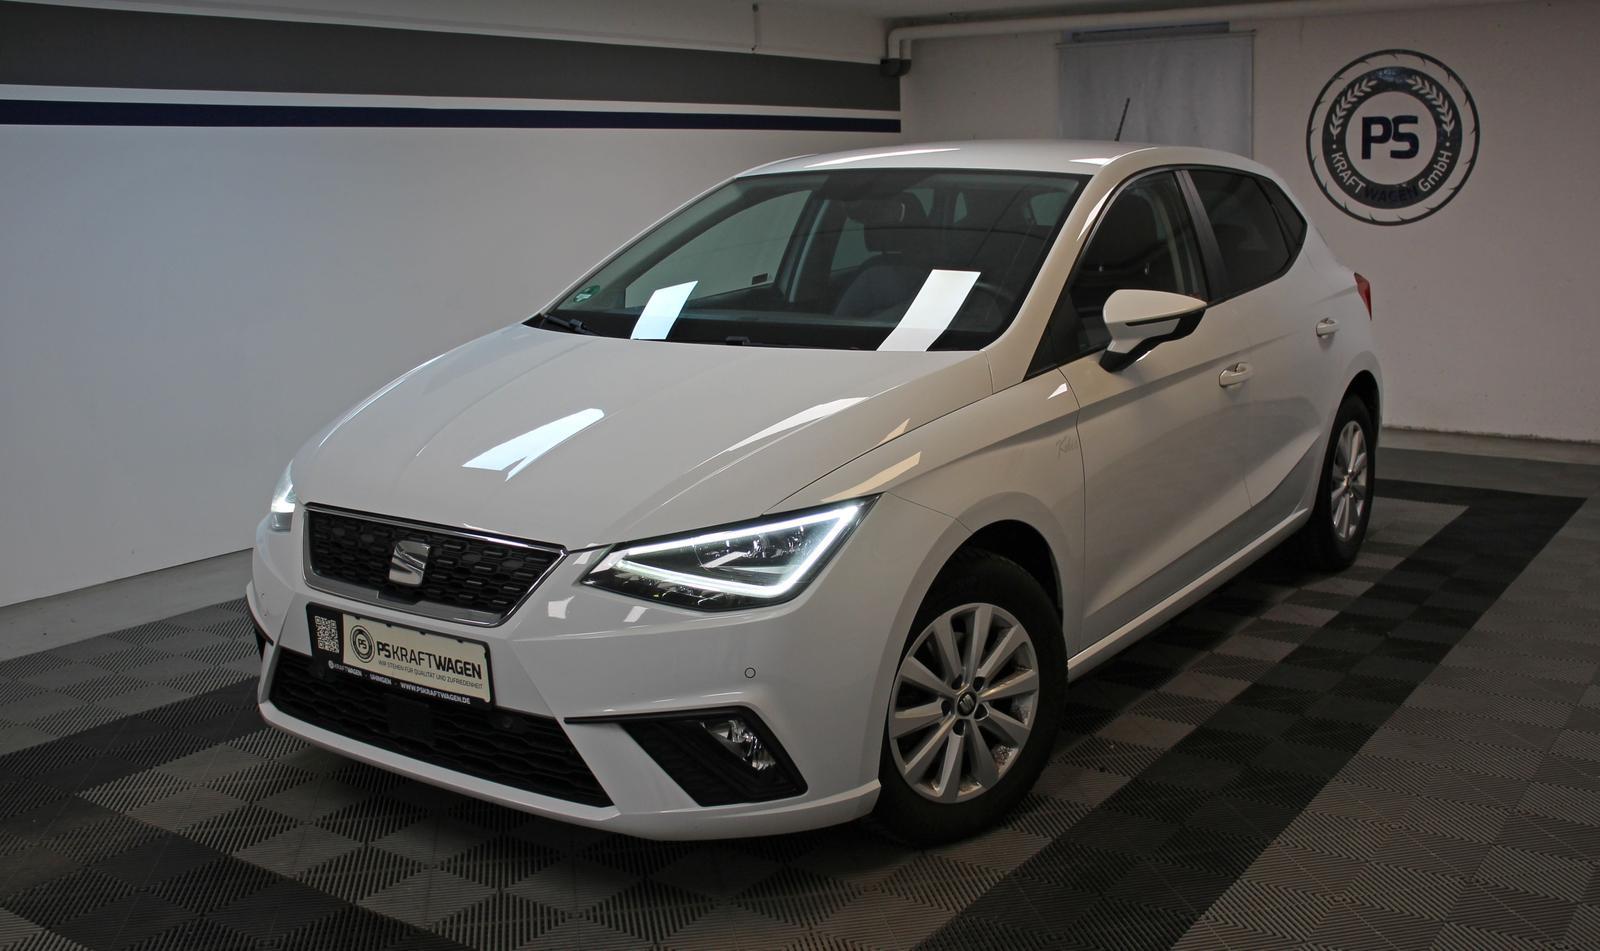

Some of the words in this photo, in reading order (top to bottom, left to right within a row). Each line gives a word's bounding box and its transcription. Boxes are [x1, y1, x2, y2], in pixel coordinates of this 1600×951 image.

[1361, 115, 1420, 160] PS
[1418, 150, 1453, 193] GmbH
[357, 638, 368, 650] PS
